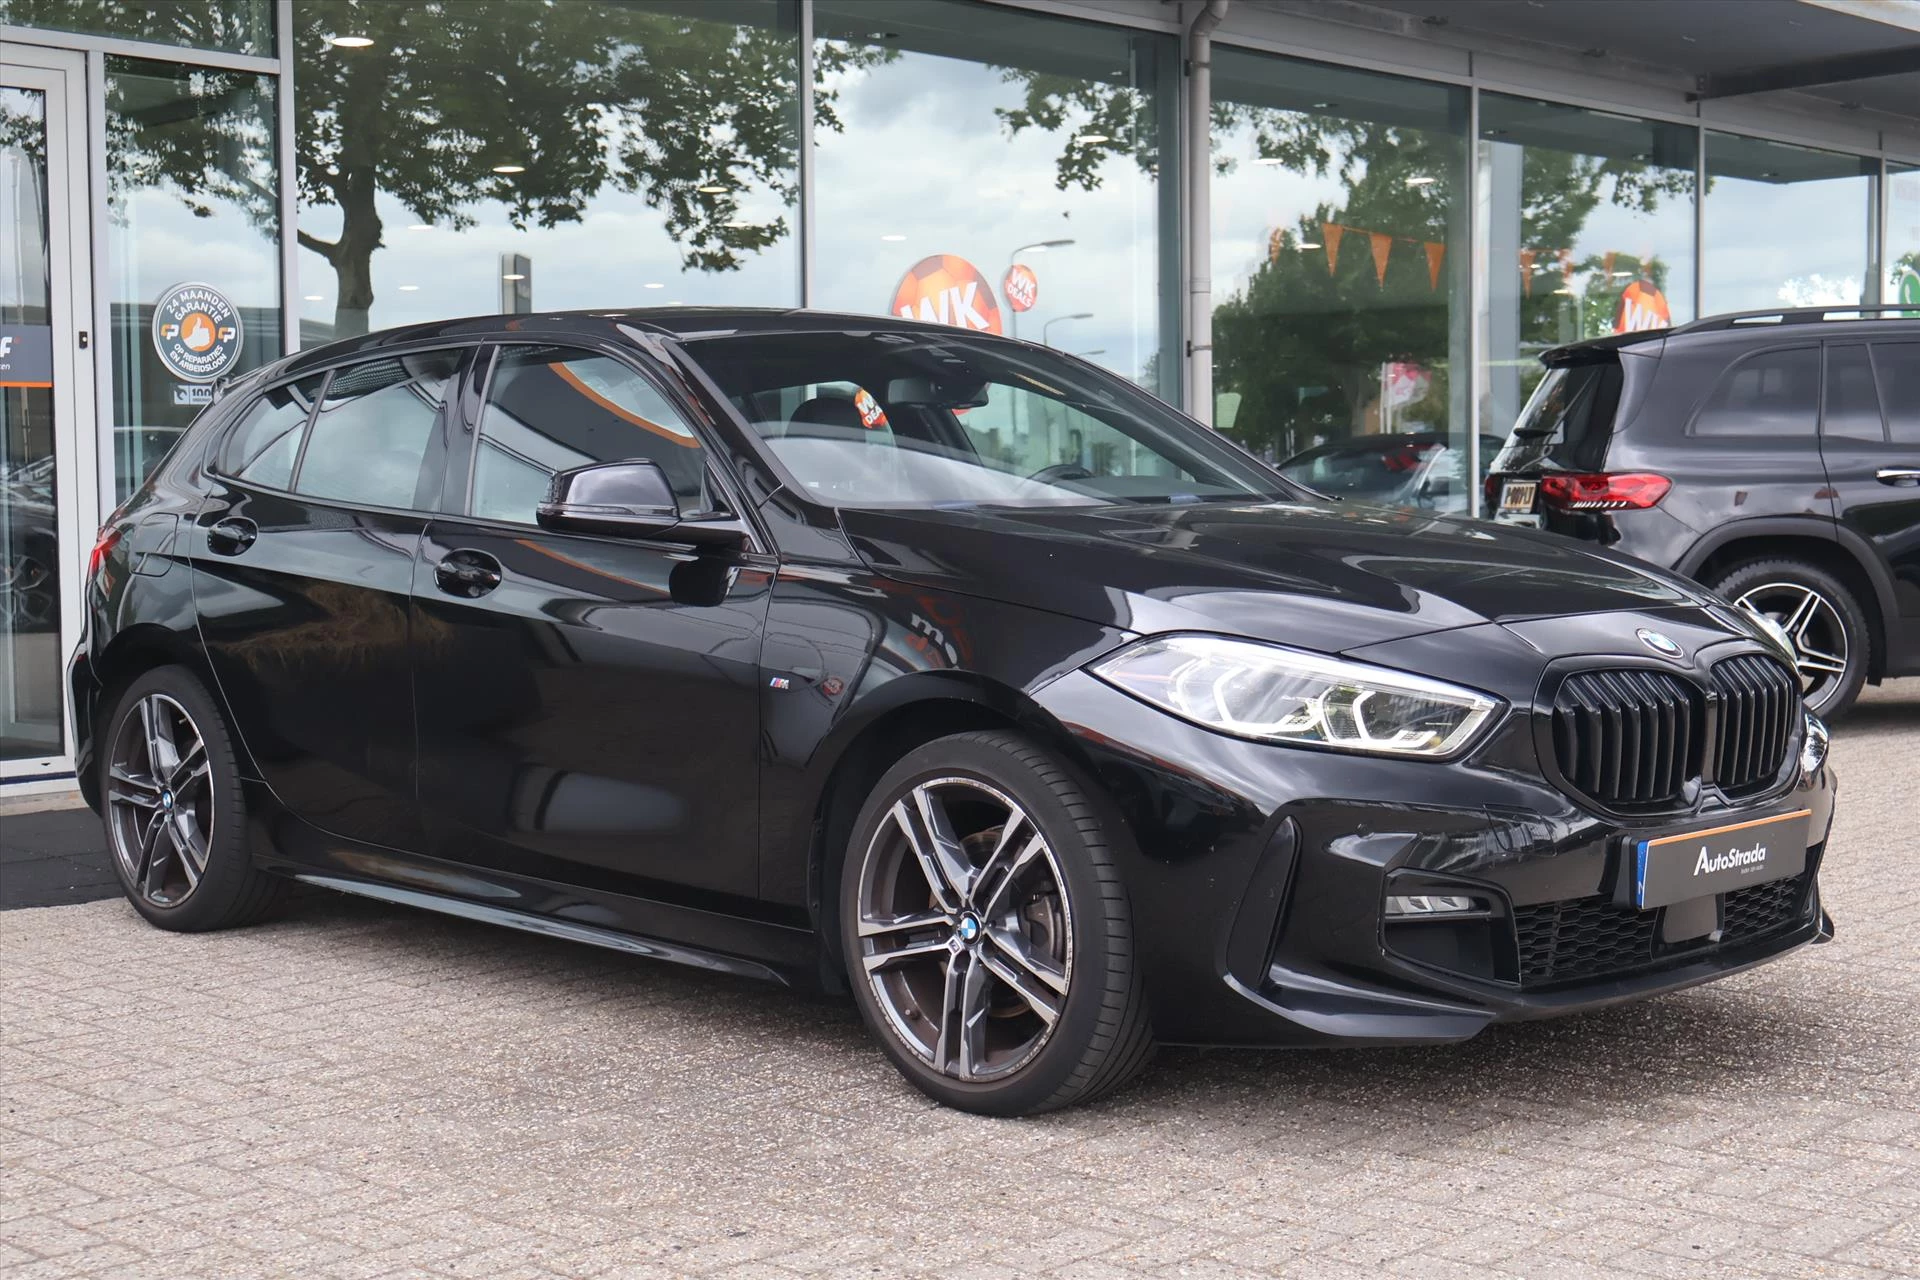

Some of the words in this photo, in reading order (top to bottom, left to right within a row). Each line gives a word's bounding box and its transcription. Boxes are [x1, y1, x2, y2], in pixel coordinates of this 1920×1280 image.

[1012, 269, 1035, 298] WK
[167, 298, 179, 314] 24
[179, 290, 230, 318] MAANDEN
[174, 301, 223, 324] GARANTIE
[169, 350, 180, 363] EN
[178, 353, 227, 373] ARBEIDSLOON
[174, 343, 185, 355] OP
[183, 344, 224, 363] REPARATIES
[1693, 842, 1767, 876] AutoStrada
